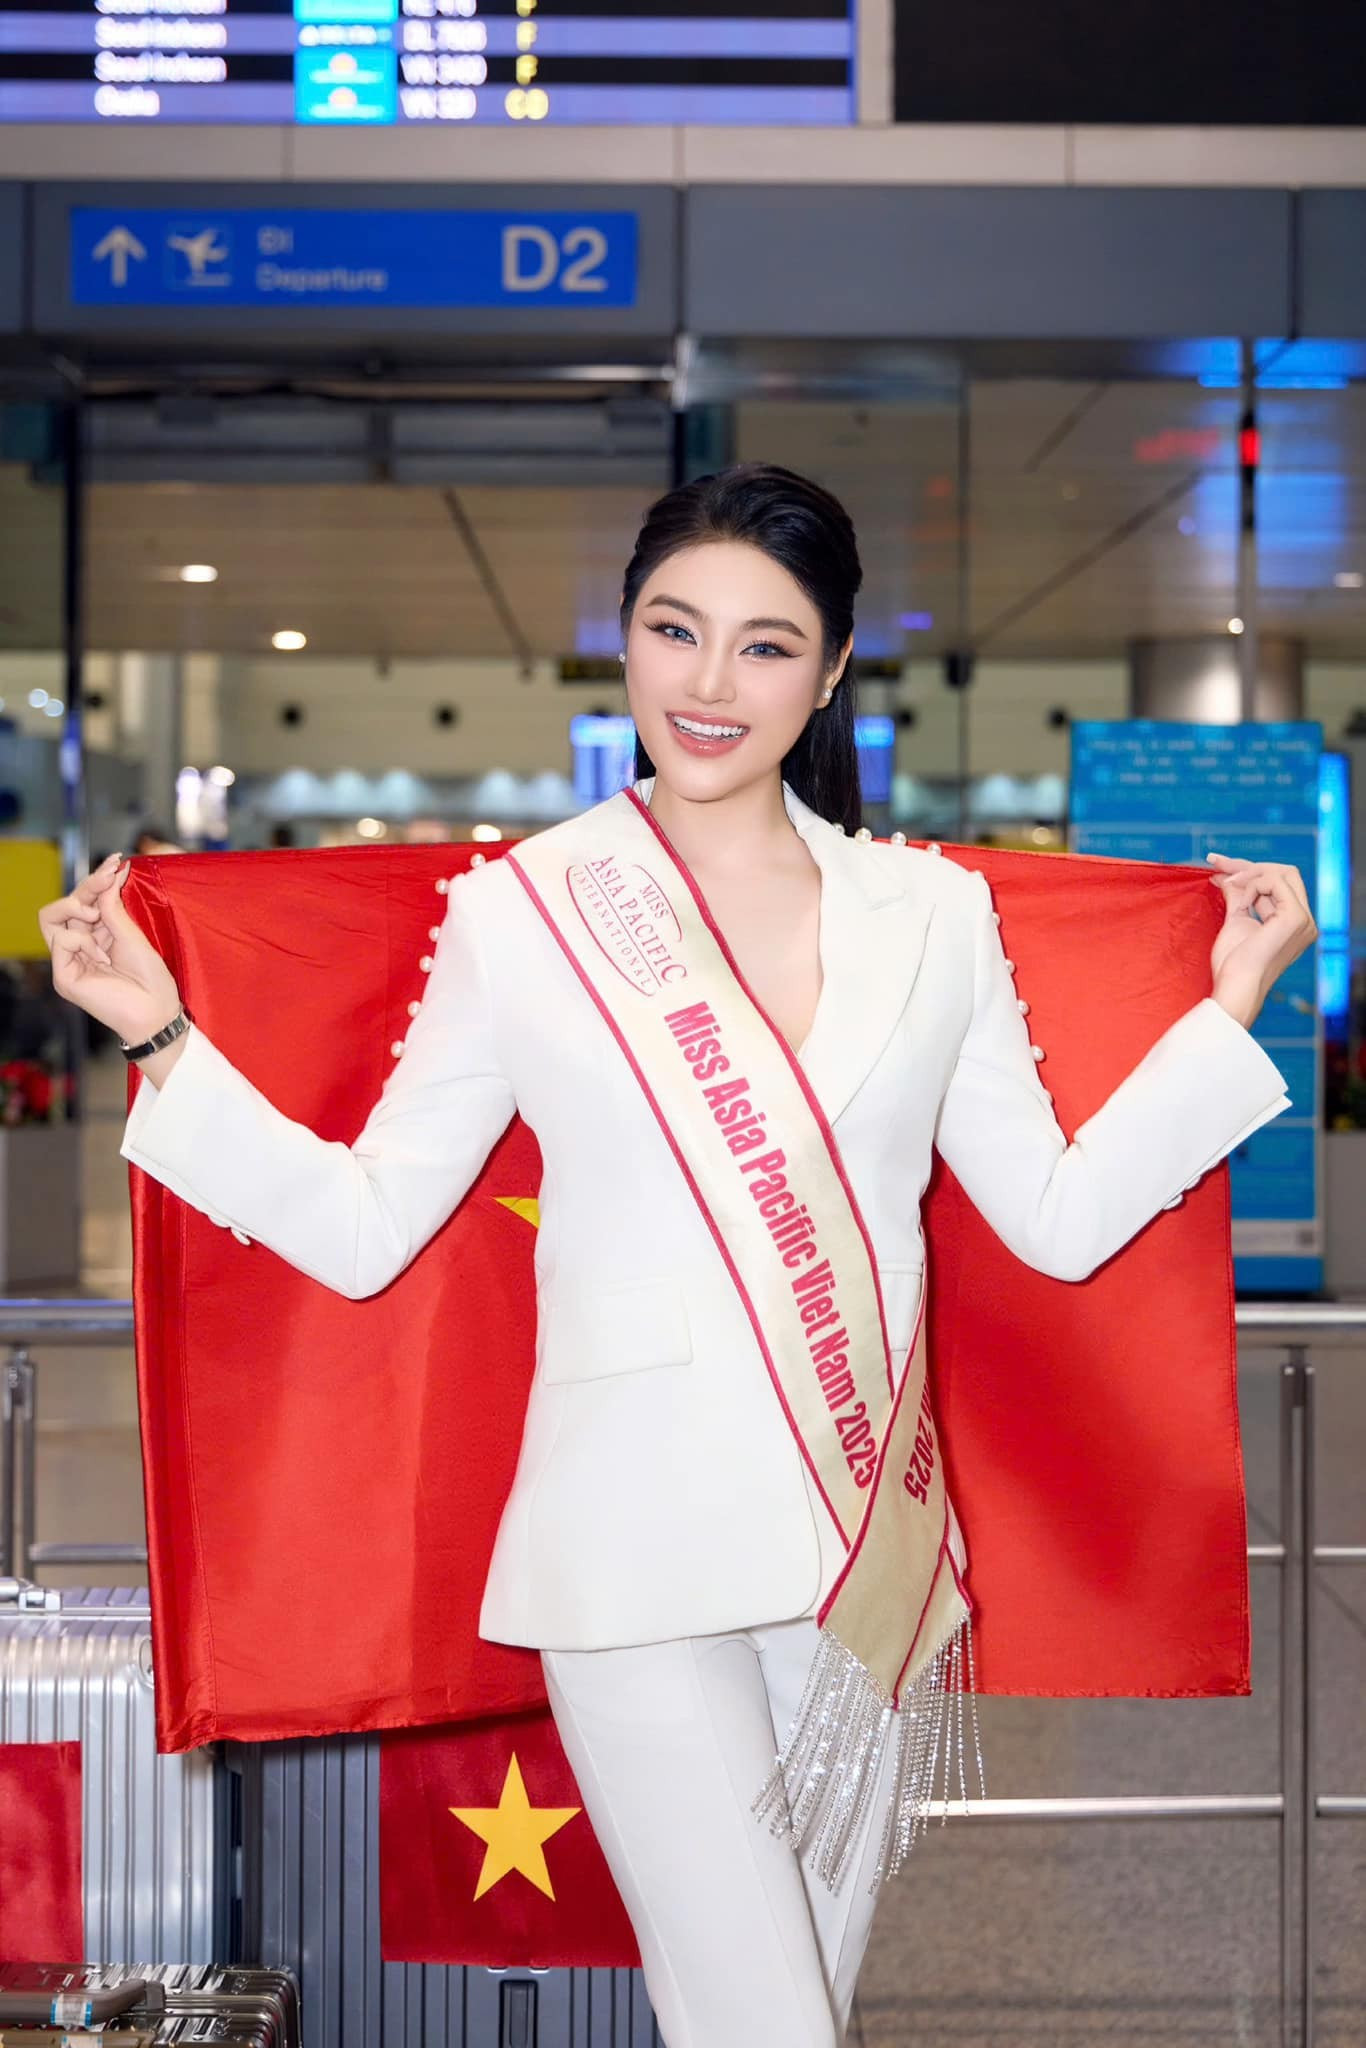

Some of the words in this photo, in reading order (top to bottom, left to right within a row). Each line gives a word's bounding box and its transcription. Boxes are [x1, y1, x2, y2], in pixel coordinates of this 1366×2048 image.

[502, 225, 607, 292] D2
[573, 871, 652, 987] INTERNATIONAL
[591, 856, 627, 898] ASIA
[619, 898, 688, 983] PACIFIC
[640, 884, 669, 919] MISS
[664, 1001, 730, 1081] Miss
[701, 1077, 767, 1157] Asia
[739, 1148, 817, 1269] Pacific
[791, 1258, 841, 1339] Viet
[809, 1327, 856, 1413] Nam
[834, 1401, 878, 1489] 2025
[904, 1414, 934, 1505] 2025
